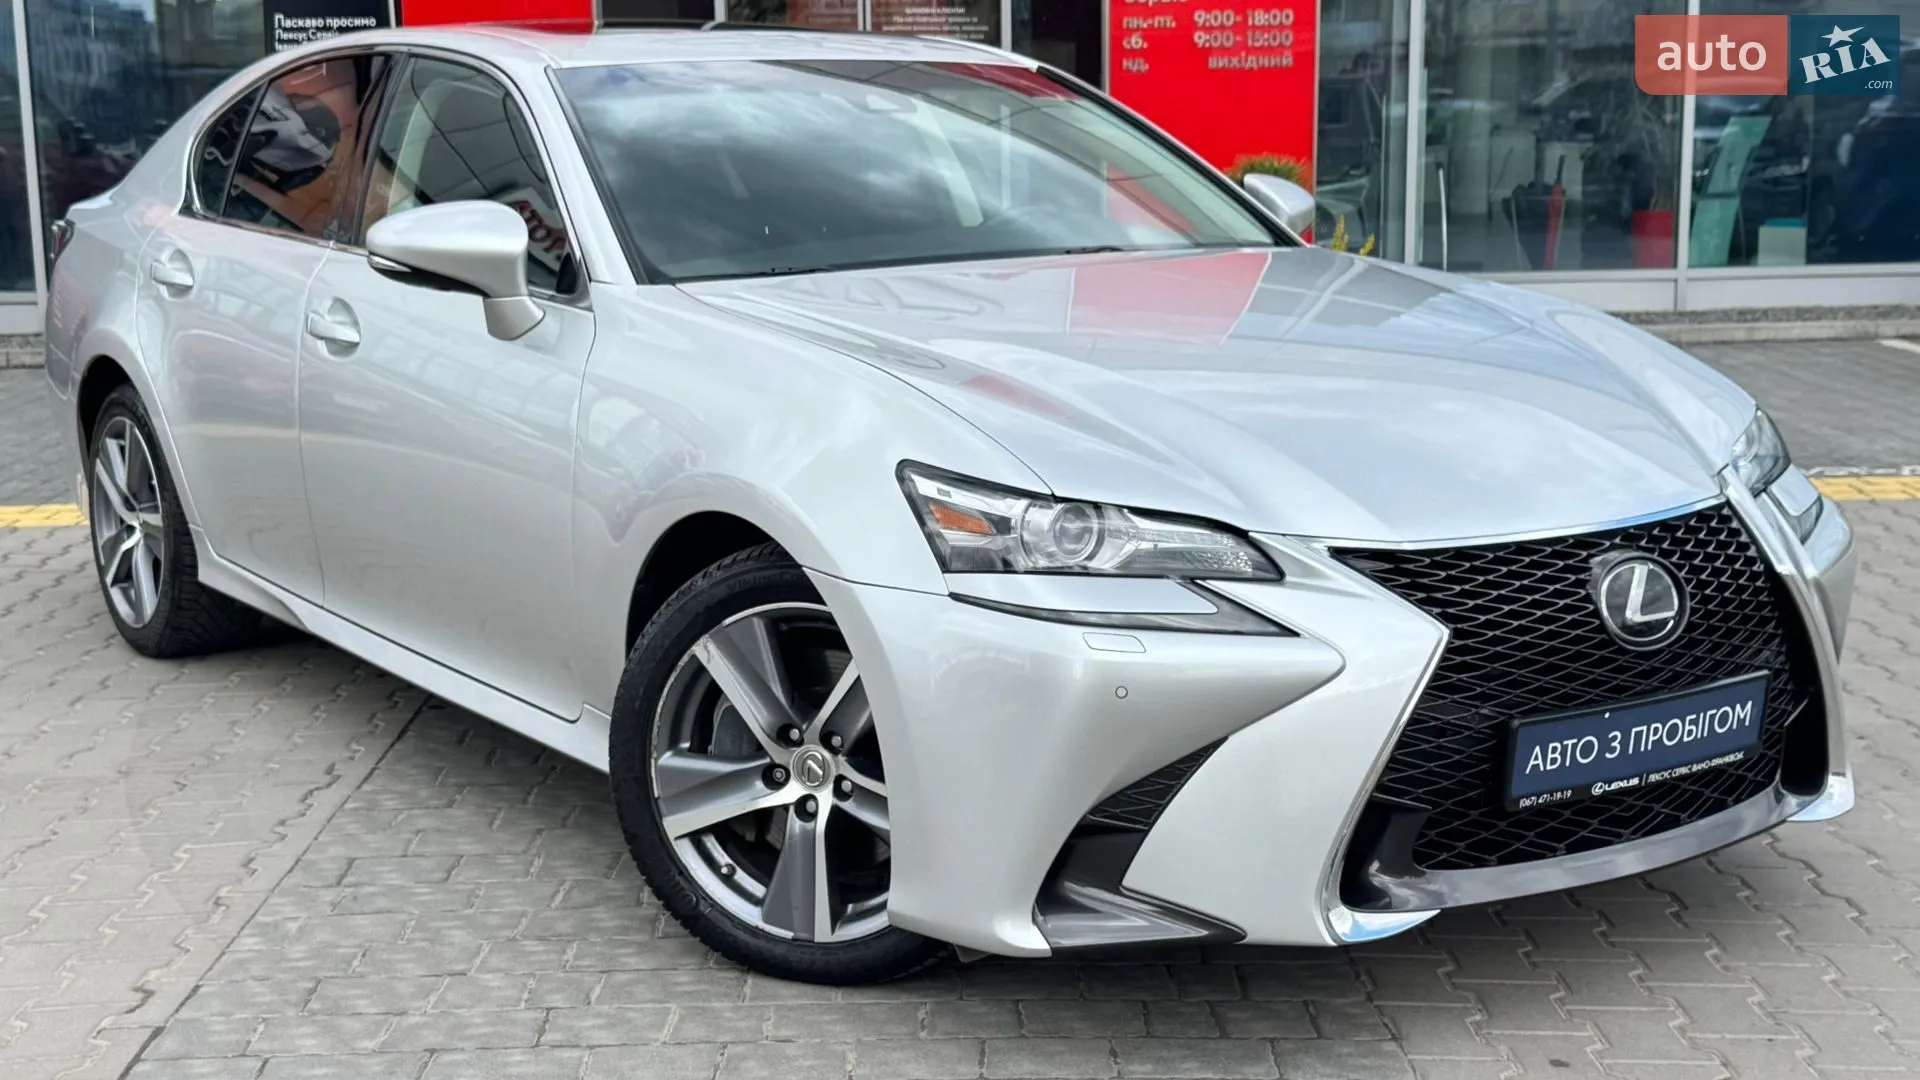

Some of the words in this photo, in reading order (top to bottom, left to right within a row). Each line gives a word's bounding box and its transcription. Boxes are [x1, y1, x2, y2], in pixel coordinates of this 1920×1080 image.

[326, 16, 377, 30] просимо
[1122, 32, 1148, 49] сб.
[1122, 57, 1149, 73] нд.
[1208, 50, 1294, 70] вихідний
[1525, 735, 1599, 774] АВТО
[1604, 731, 1622, 759] З
[1628, 700, 1753, 754] ПРОБІГОМ
[1605, 777, 1640, 791] LEXUS
